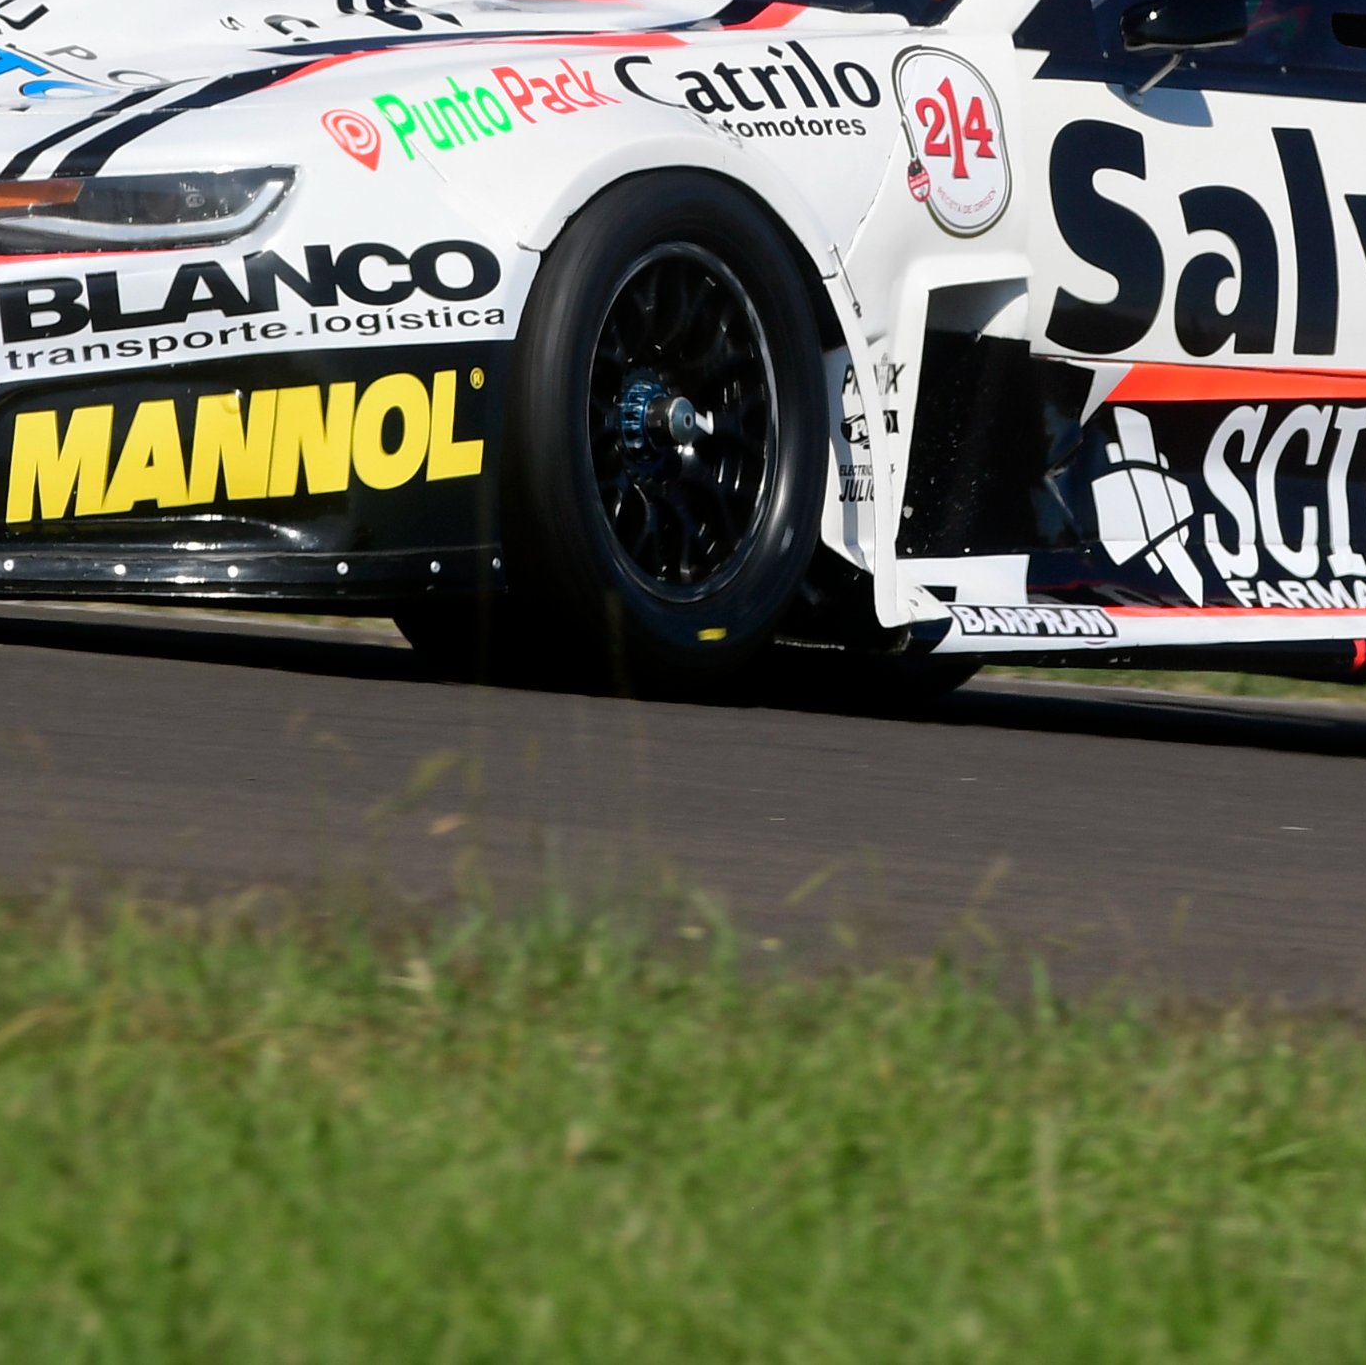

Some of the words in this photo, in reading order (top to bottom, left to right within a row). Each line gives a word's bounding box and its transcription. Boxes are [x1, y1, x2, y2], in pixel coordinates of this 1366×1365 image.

[613, 39, 881, 115] Catrilo
[719, 115, 867, 139] tomotores
[4, 304, 506, 372] transporte.logística
[5, 368, 484, 524] MANNOL
[950, 605, 1115, 636] BARPRAN
